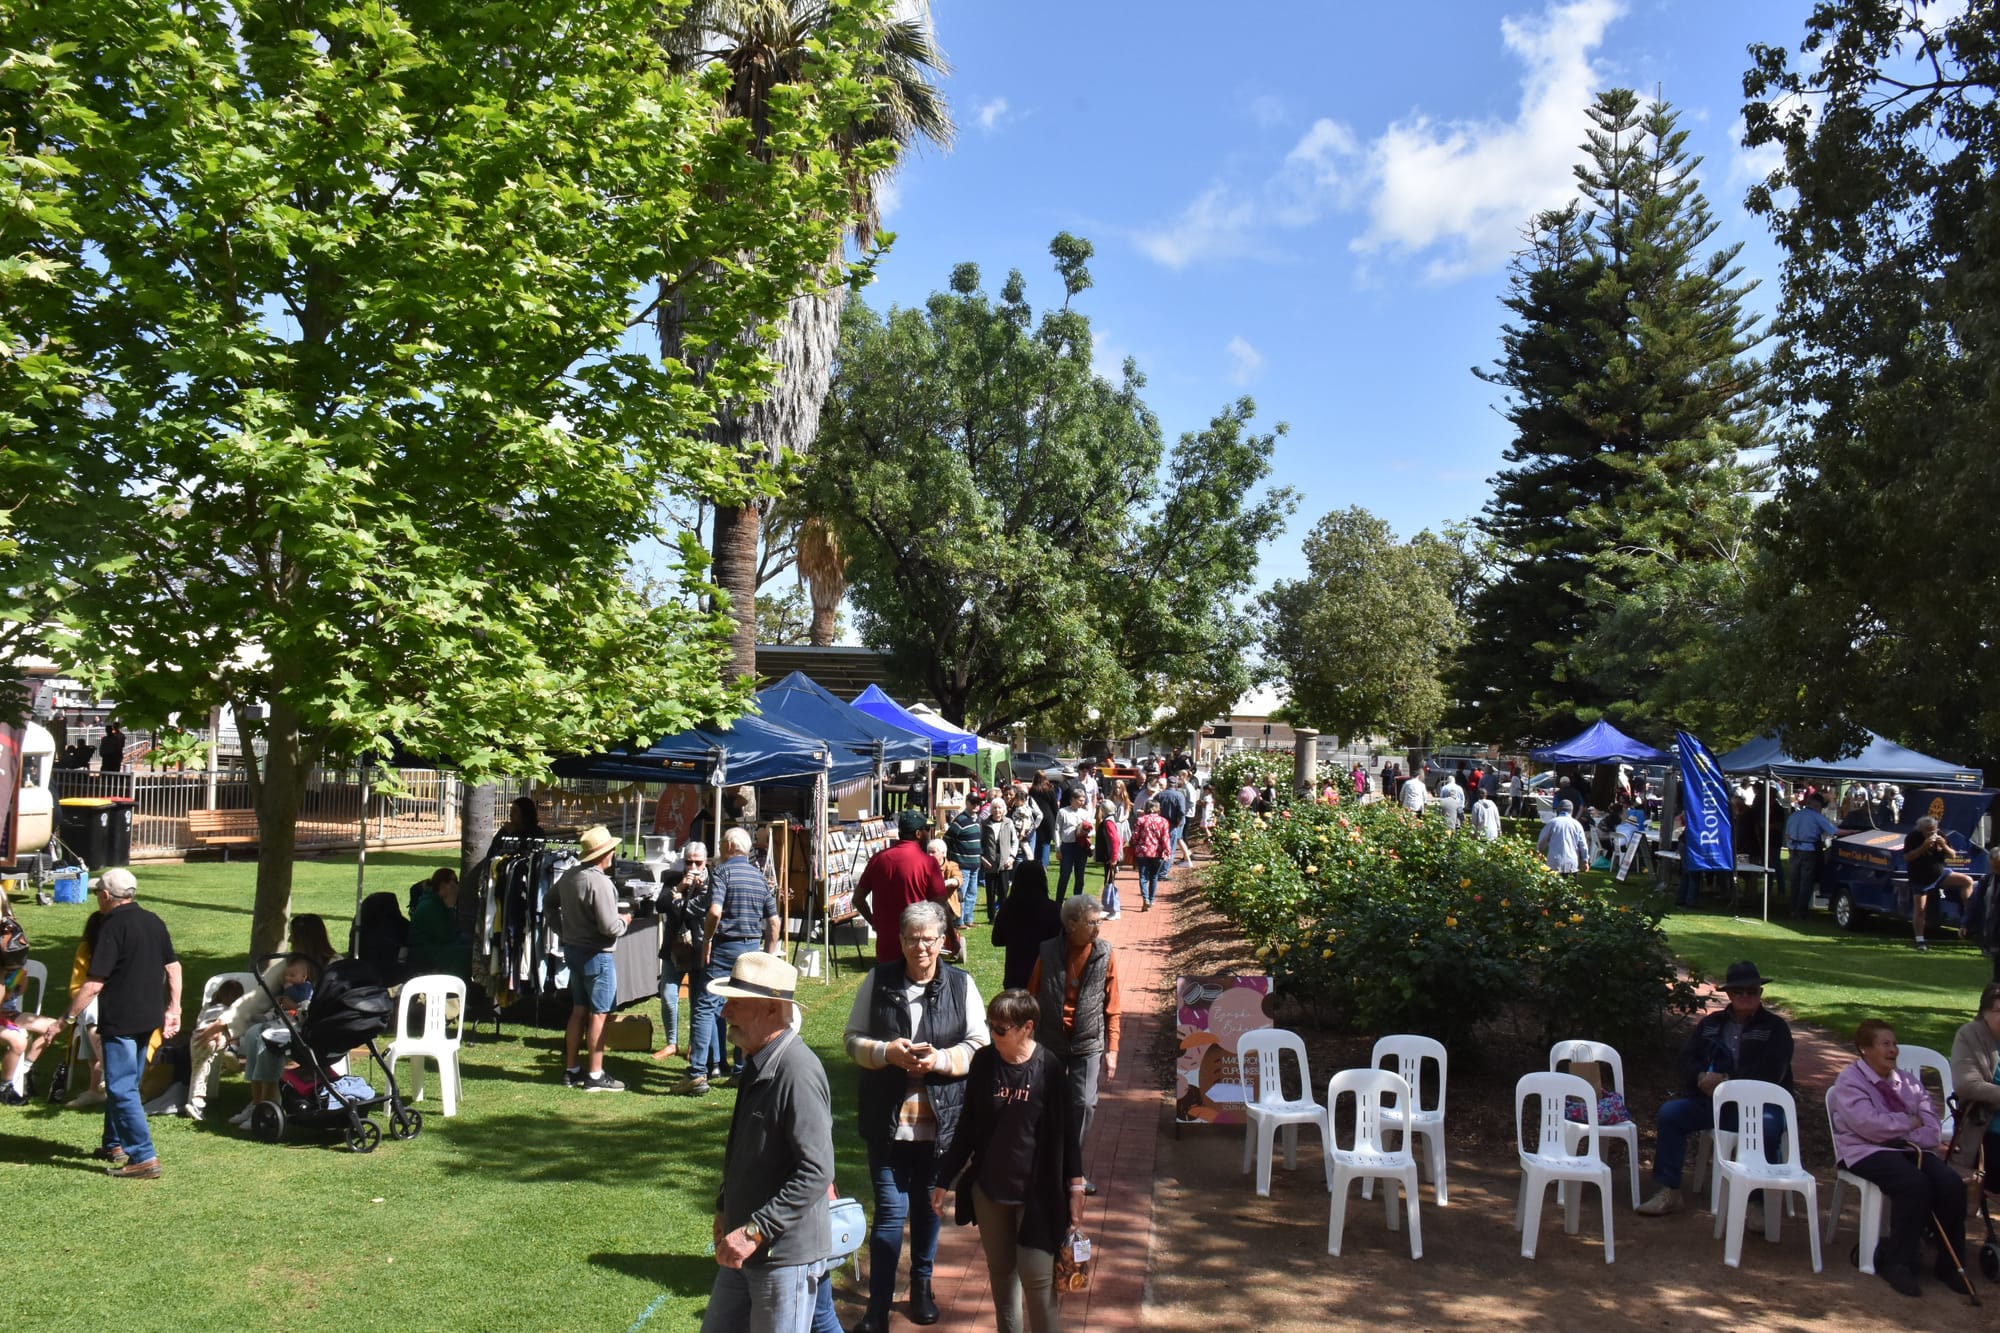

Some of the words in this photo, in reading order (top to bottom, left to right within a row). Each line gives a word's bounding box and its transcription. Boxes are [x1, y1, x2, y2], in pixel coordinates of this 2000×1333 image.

[1700, 778, 1719, 845] Rotary
[1222, 1056, 1259, 1065] MACRO
[1222, 1066, 1259, 1076] CUPCKES
[1222, 1077, 1255, 1086] COOES
